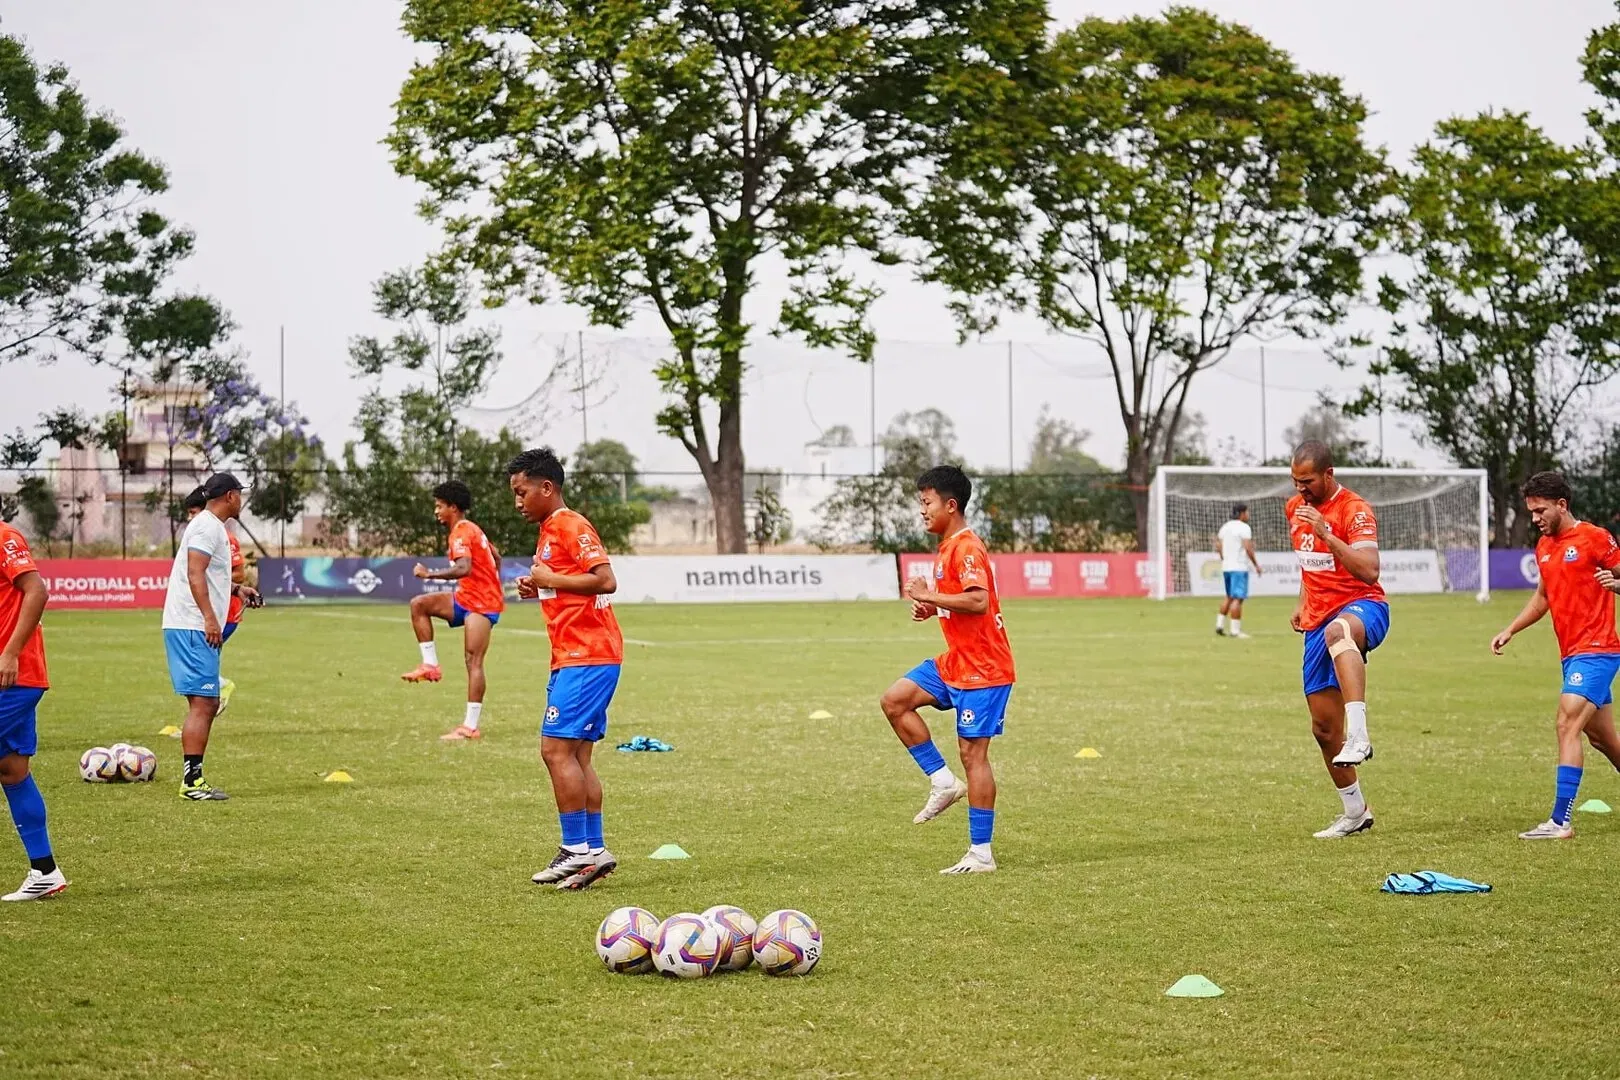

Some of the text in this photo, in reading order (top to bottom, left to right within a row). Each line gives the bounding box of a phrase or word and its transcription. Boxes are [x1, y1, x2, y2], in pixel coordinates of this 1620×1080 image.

[1300, 533, 1315, 552] 23
[55, 577, 136, 591] FOOTBALL
[137, 576, 169, 590] CLU
[686, 565, 823, 586] namdharis
